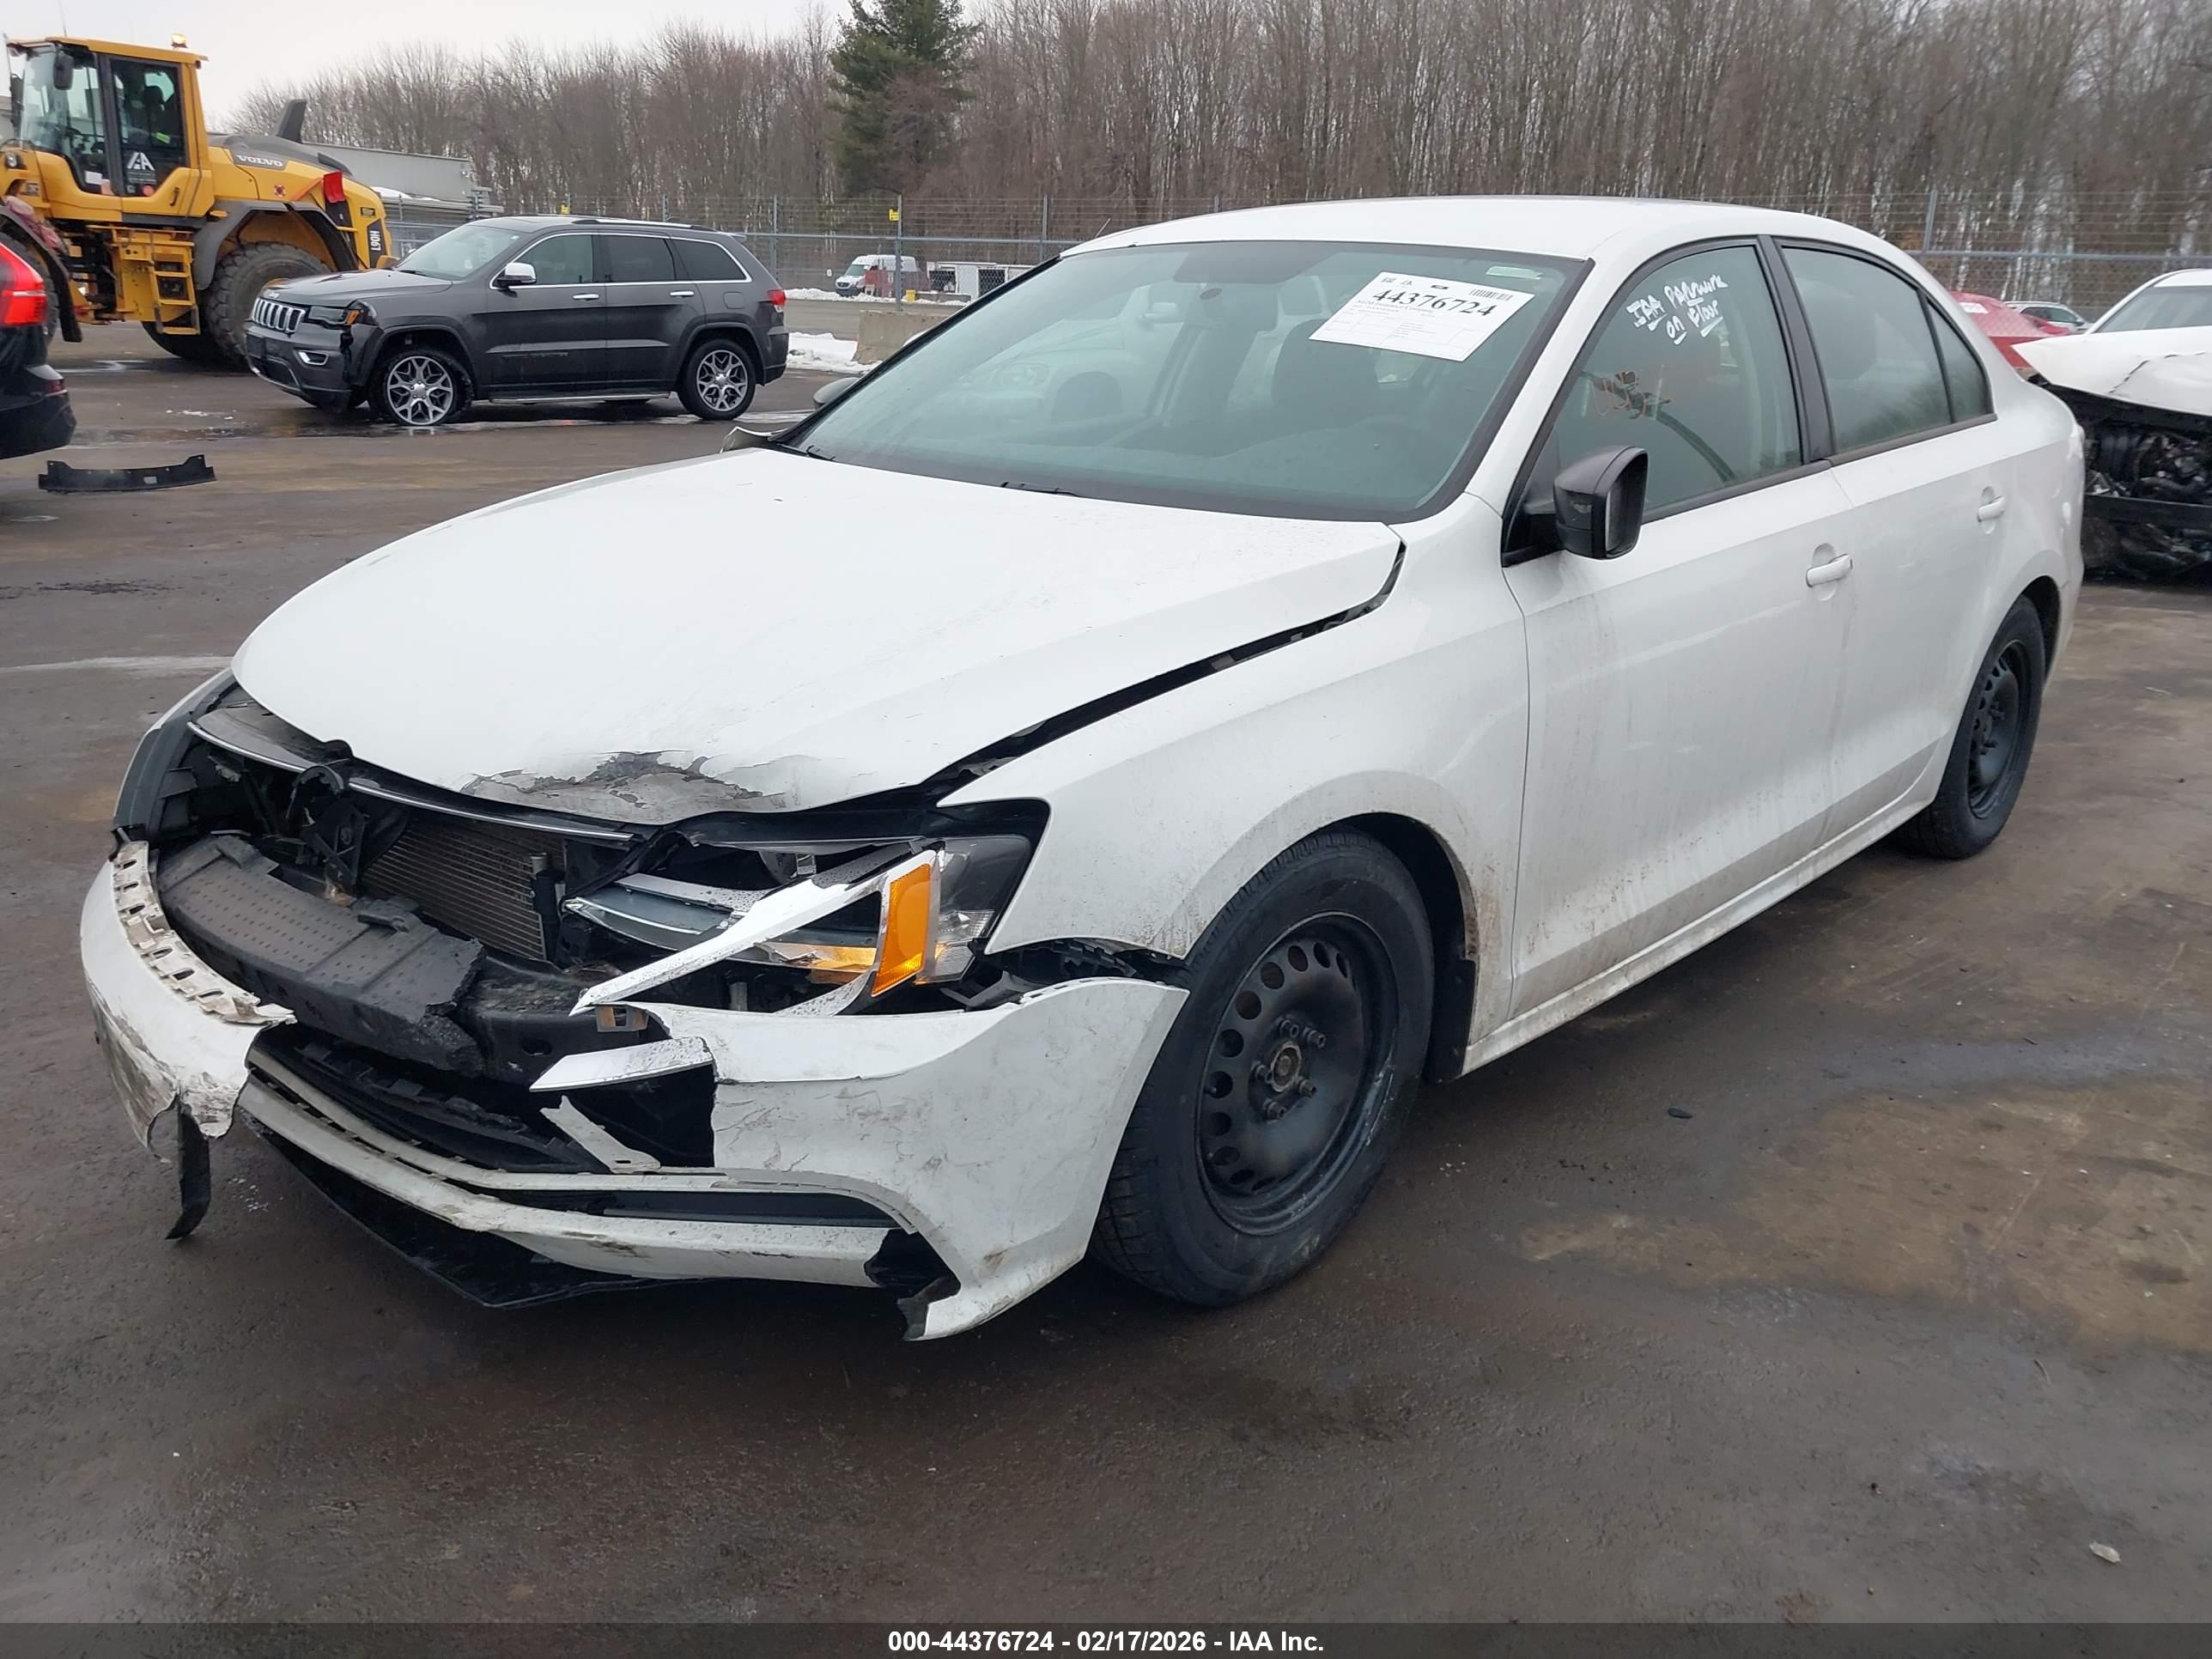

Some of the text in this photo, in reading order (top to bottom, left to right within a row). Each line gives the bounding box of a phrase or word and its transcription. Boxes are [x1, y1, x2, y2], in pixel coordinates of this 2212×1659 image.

[235, 154, 283, 167] VOLVO
[369, 230, 382, 252] L90H
[1372, 289, 1498, 317] 44376724
